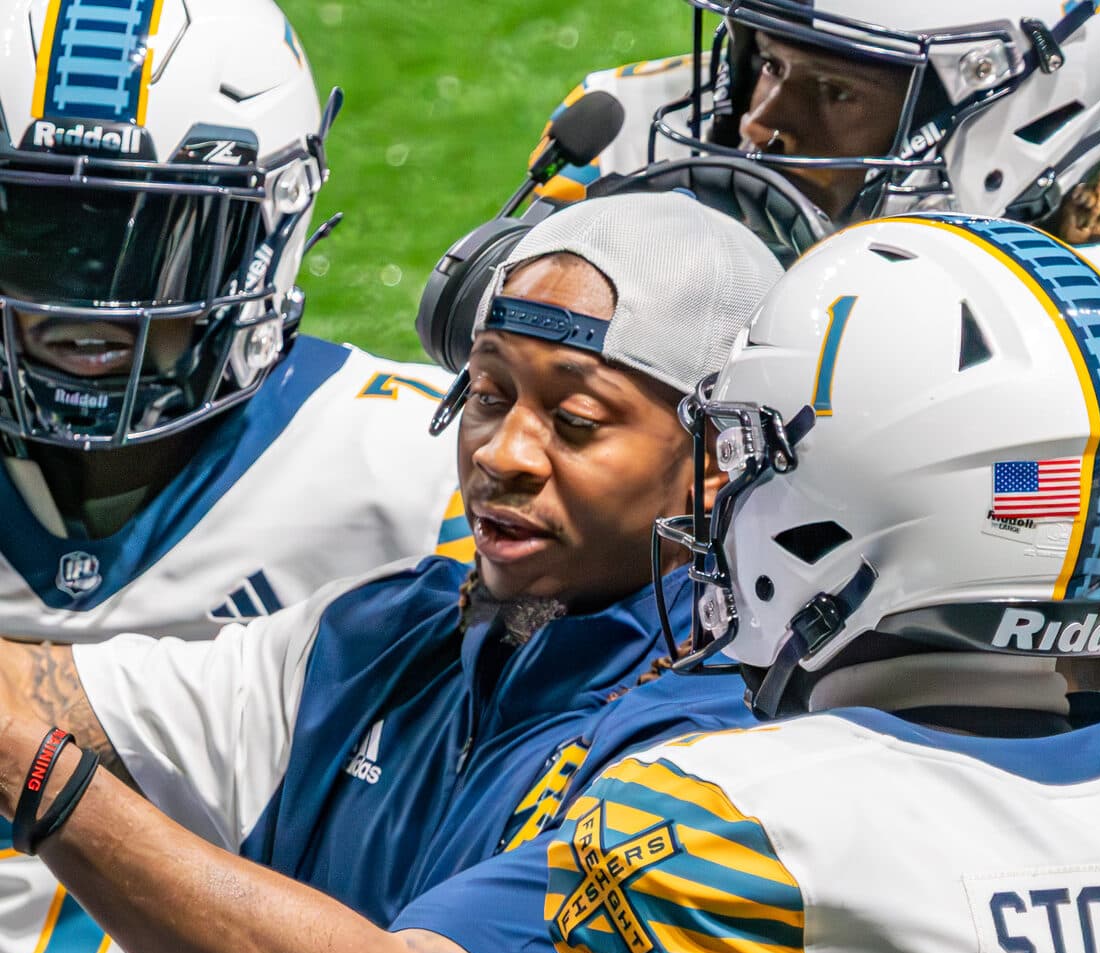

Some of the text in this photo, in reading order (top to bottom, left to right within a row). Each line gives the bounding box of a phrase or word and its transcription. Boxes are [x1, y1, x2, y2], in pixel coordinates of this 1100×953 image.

[34, 121, 141, 153] Riddell
[811, 296, 858, 417] 1
[27, 727, 68, 792] RAINING
[561, 836, 666, 933] FISHERS
[578, 817, 645, 948] FREIGHT
